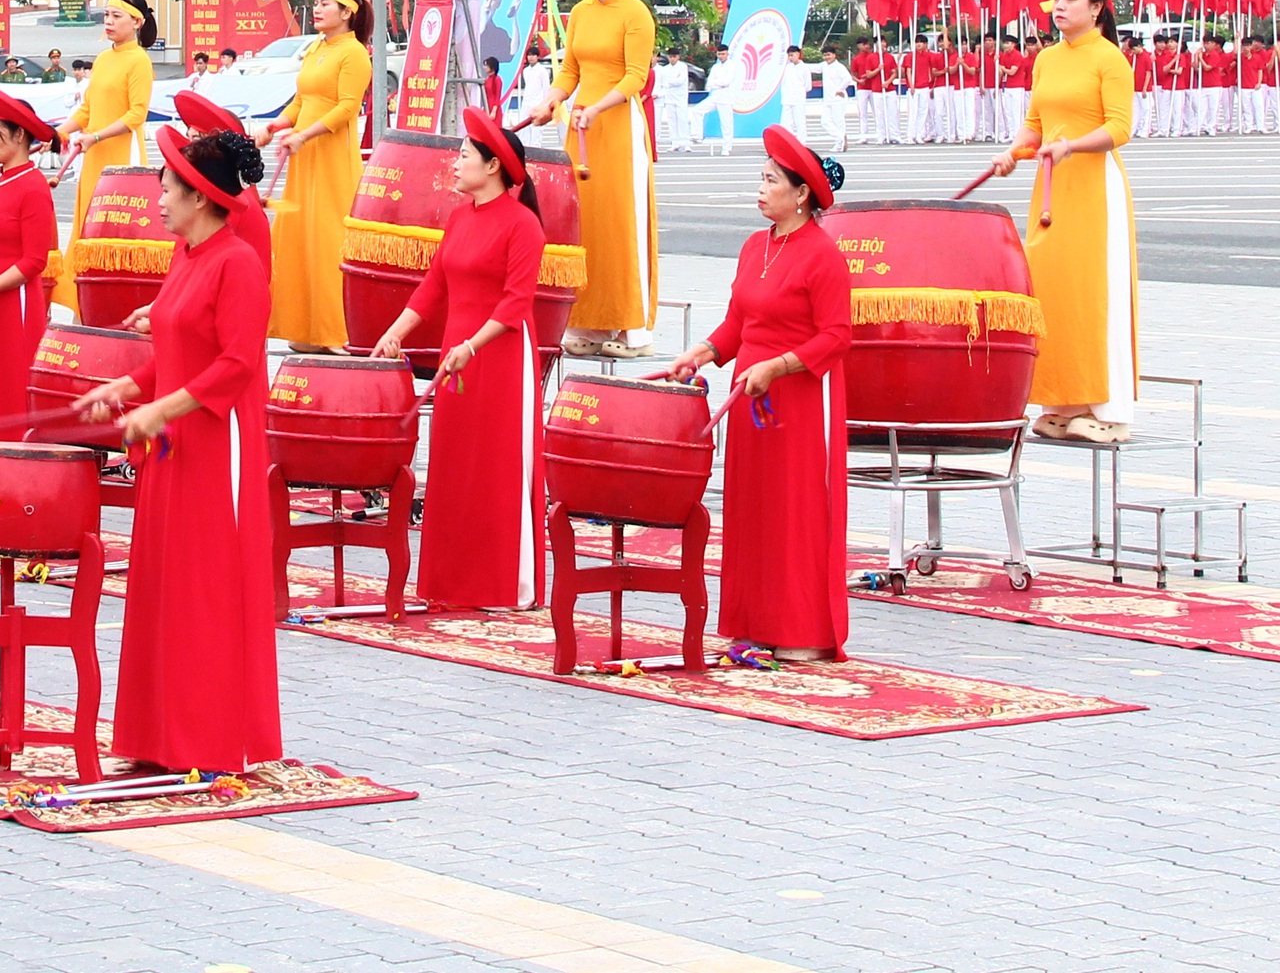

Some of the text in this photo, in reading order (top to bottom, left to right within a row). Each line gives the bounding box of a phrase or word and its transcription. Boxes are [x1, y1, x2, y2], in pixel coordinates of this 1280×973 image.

[194, 9, 217, 19] DÂN GIÀU
[190, 23, 220, 34] NƯỚC MẠNH
[235, 20, 268, 30] XIV
[195, 35, 216, 45] DÂN CHỦ
[419, 56, 432, 71] KHỎE
[407, 74, 418, 90] ĐỂ
[427, 76, 439, 92] TẬP
[407, 113, 418, 127] XÂY
[385, 168, 403, 184] HỘI
[102, 190, 127, 207] TRỐNG
[129, 196, 149, 211] HỘI
[107, 210, 131, 226] THẠCH
[836, 234, 885, 256] ỐNG HỘI
[64, 342, 81, 356] HỘI
[581, 395, 599, 409] HỘI
